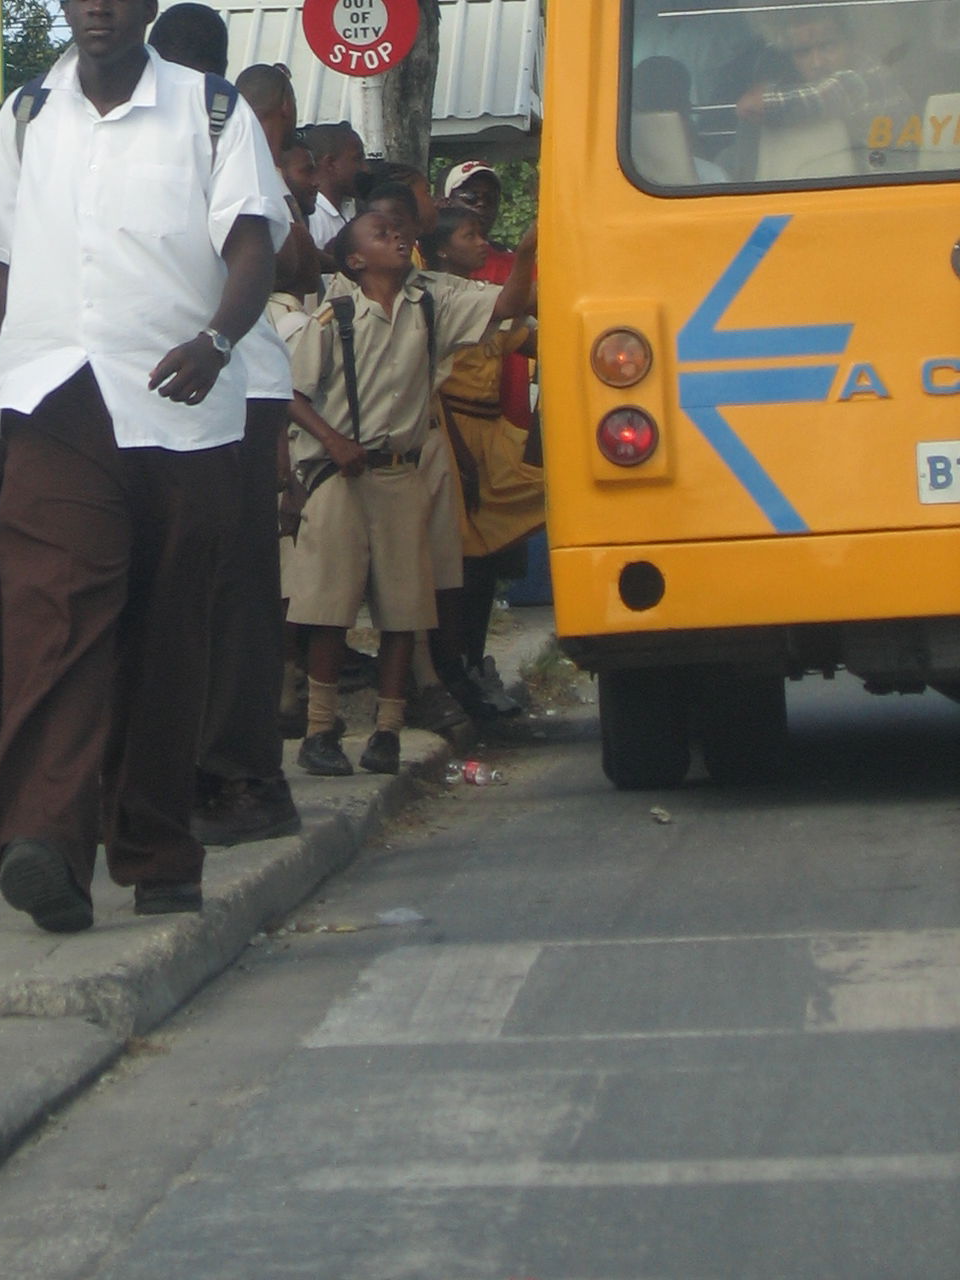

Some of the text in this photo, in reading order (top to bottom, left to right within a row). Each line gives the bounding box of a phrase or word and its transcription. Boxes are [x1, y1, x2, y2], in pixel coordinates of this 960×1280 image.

[350, 12, 370, 24] OF
[342, 27, 381, 39] CITY
[329, 42, 393, 69] STOP
[927, 455, 960, 490] B
